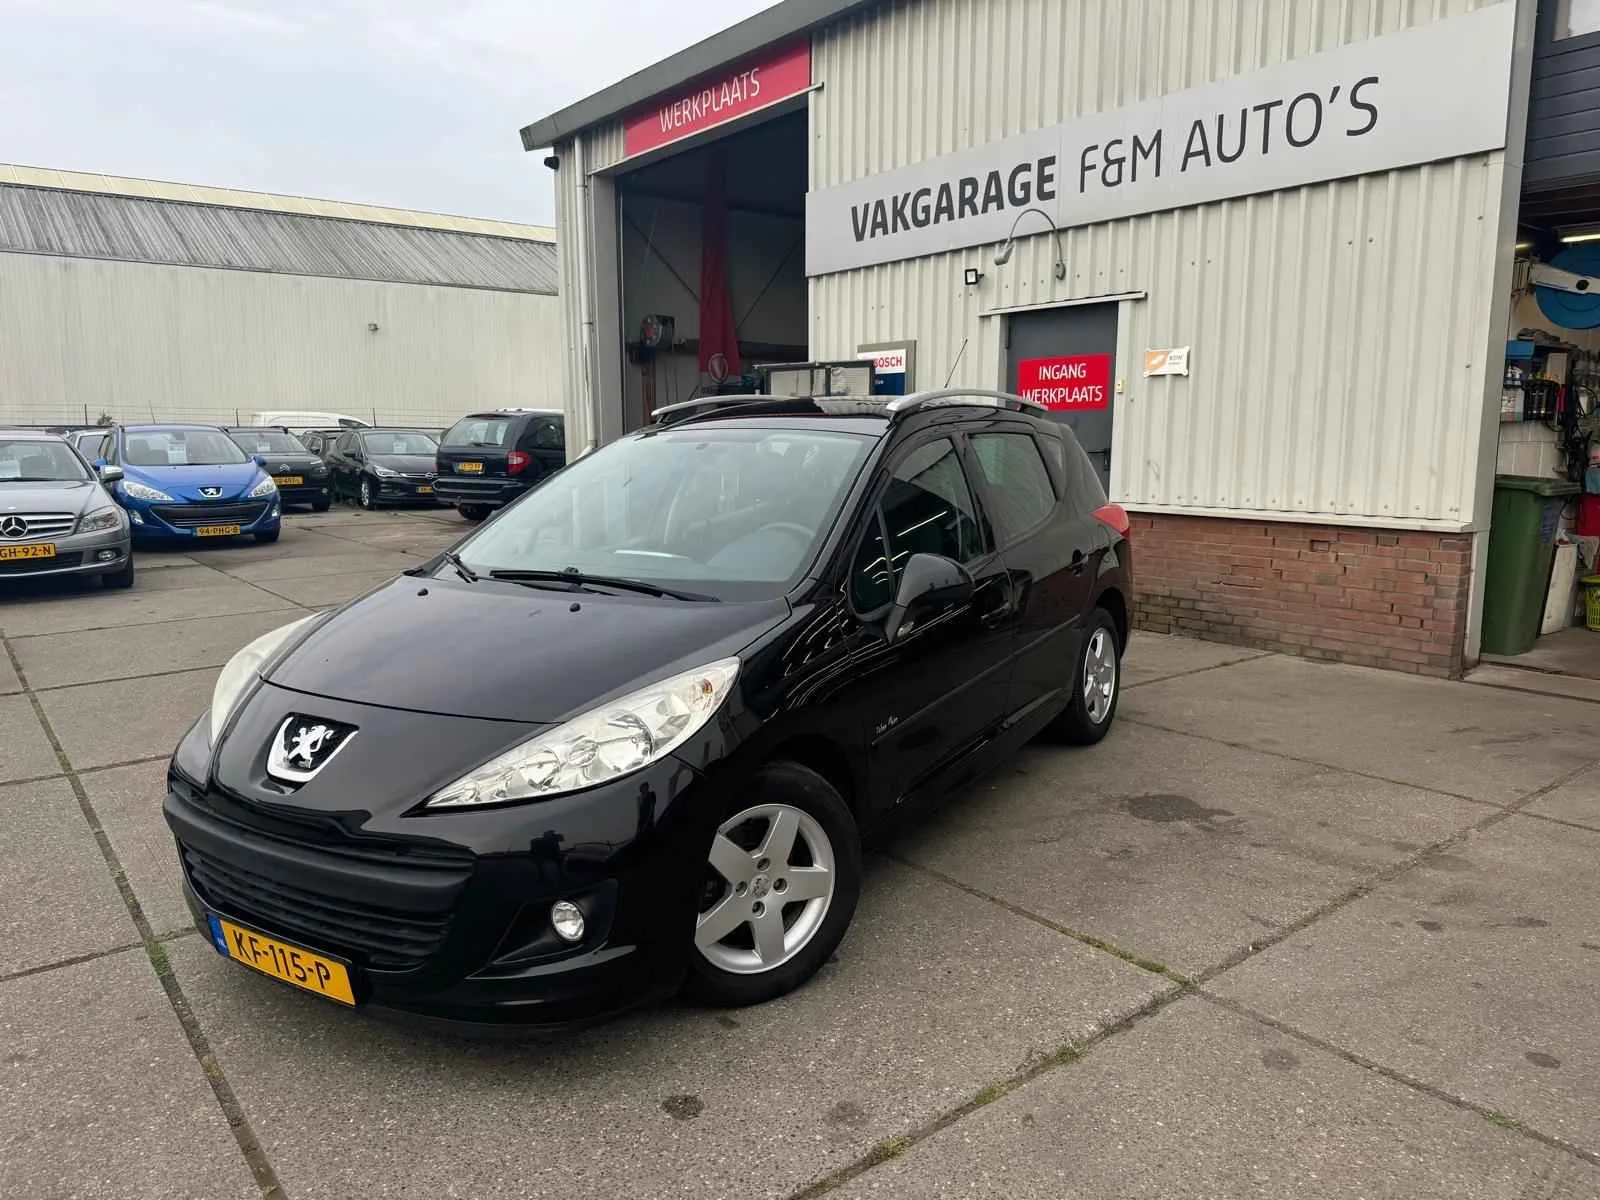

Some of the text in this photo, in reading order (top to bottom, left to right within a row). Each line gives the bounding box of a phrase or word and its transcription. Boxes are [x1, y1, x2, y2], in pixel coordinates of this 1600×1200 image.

[660, 68, 760, 133] WERKPLAATS
[851, 76, 1379, 242] VAKGARAGE F&M AUTO'S
[1022, 386, 1104, 403] WERKPLAATS
[1039, 363, 1087, 380] INGANG
[232, 929, 331, 989] KF-115-P
